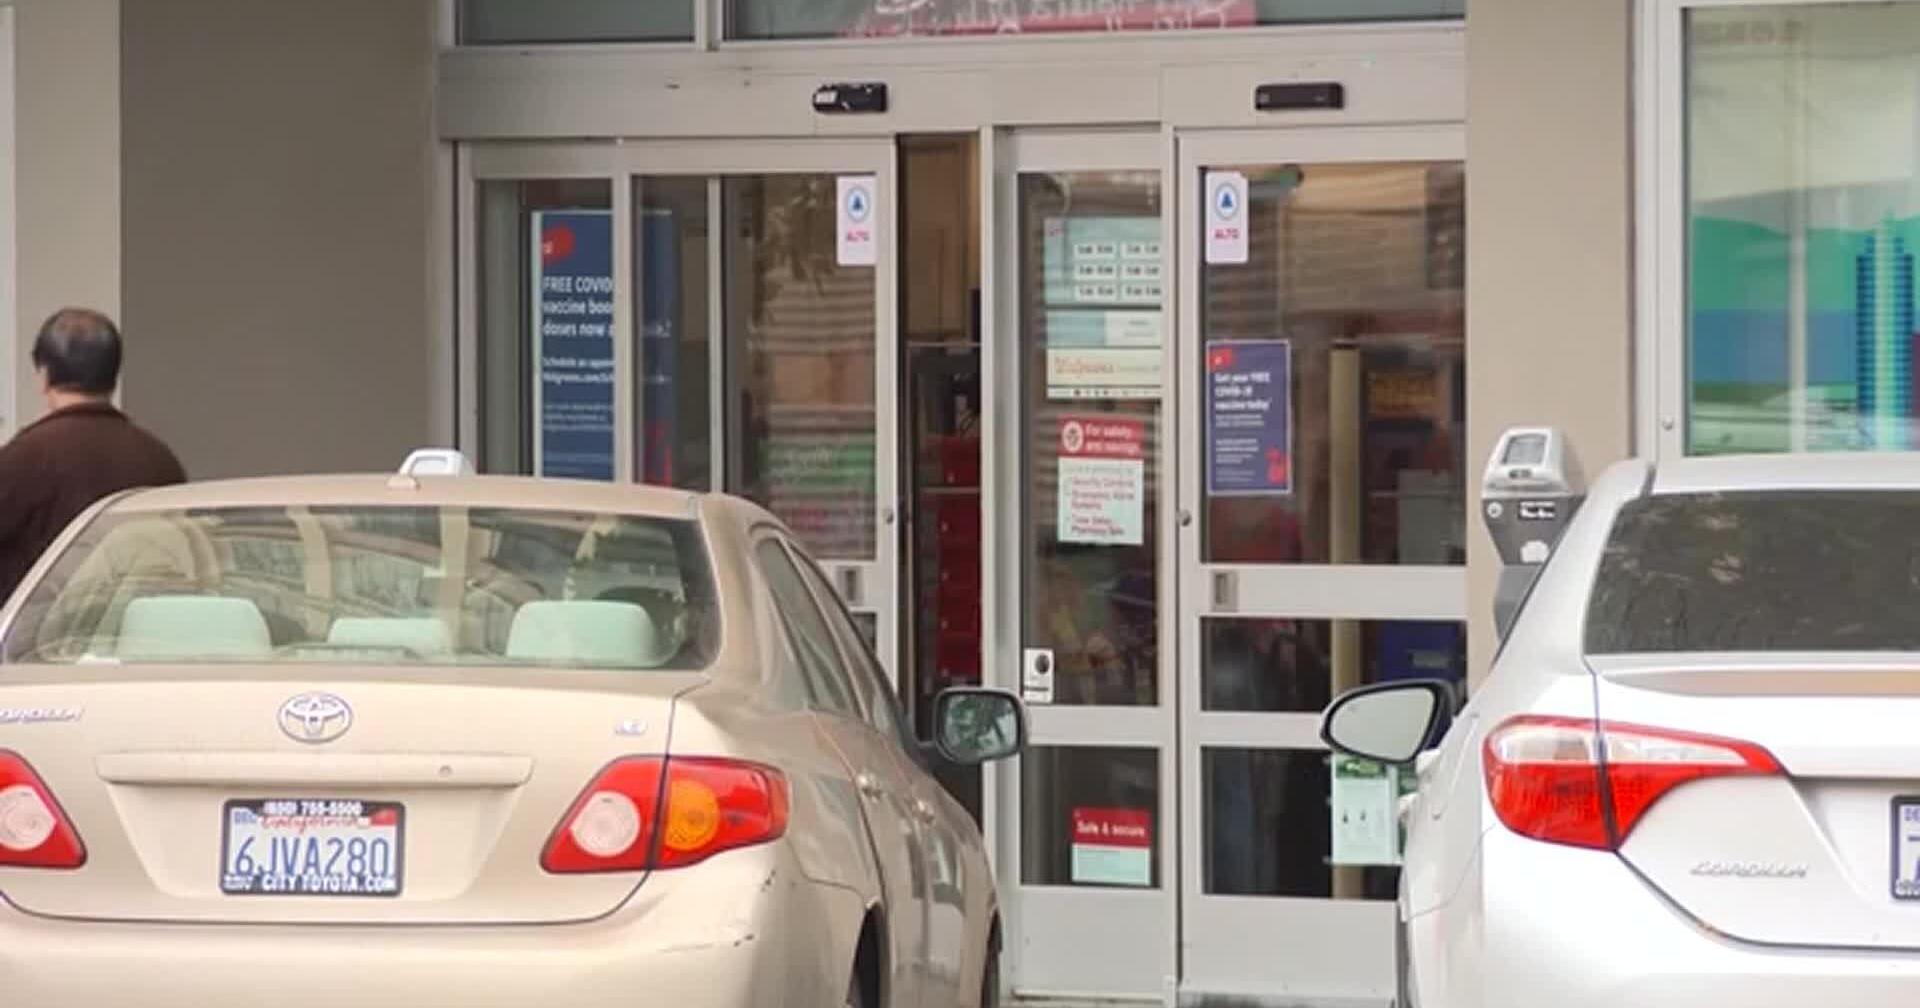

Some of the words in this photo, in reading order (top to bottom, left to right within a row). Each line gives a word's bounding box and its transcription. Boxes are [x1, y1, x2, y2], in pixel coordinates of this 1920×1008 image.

[543, 276, 573, 293] FREE
[543, 298, 586, 315] vaccine
[543, 317, 577, 336] doses
[579, 322, 606, 337] now
[1085, 424, 1101, 437] For
[1103, 425, 1132, 440] safety
[1076, 819, 1100, 836] Safe
[1101, 820, 1110, 836] &
[1111, 825, 1146, 838] secure
[234, 835, 391, 878] 6JVA280
[261, 875, 297, 892] CITY
